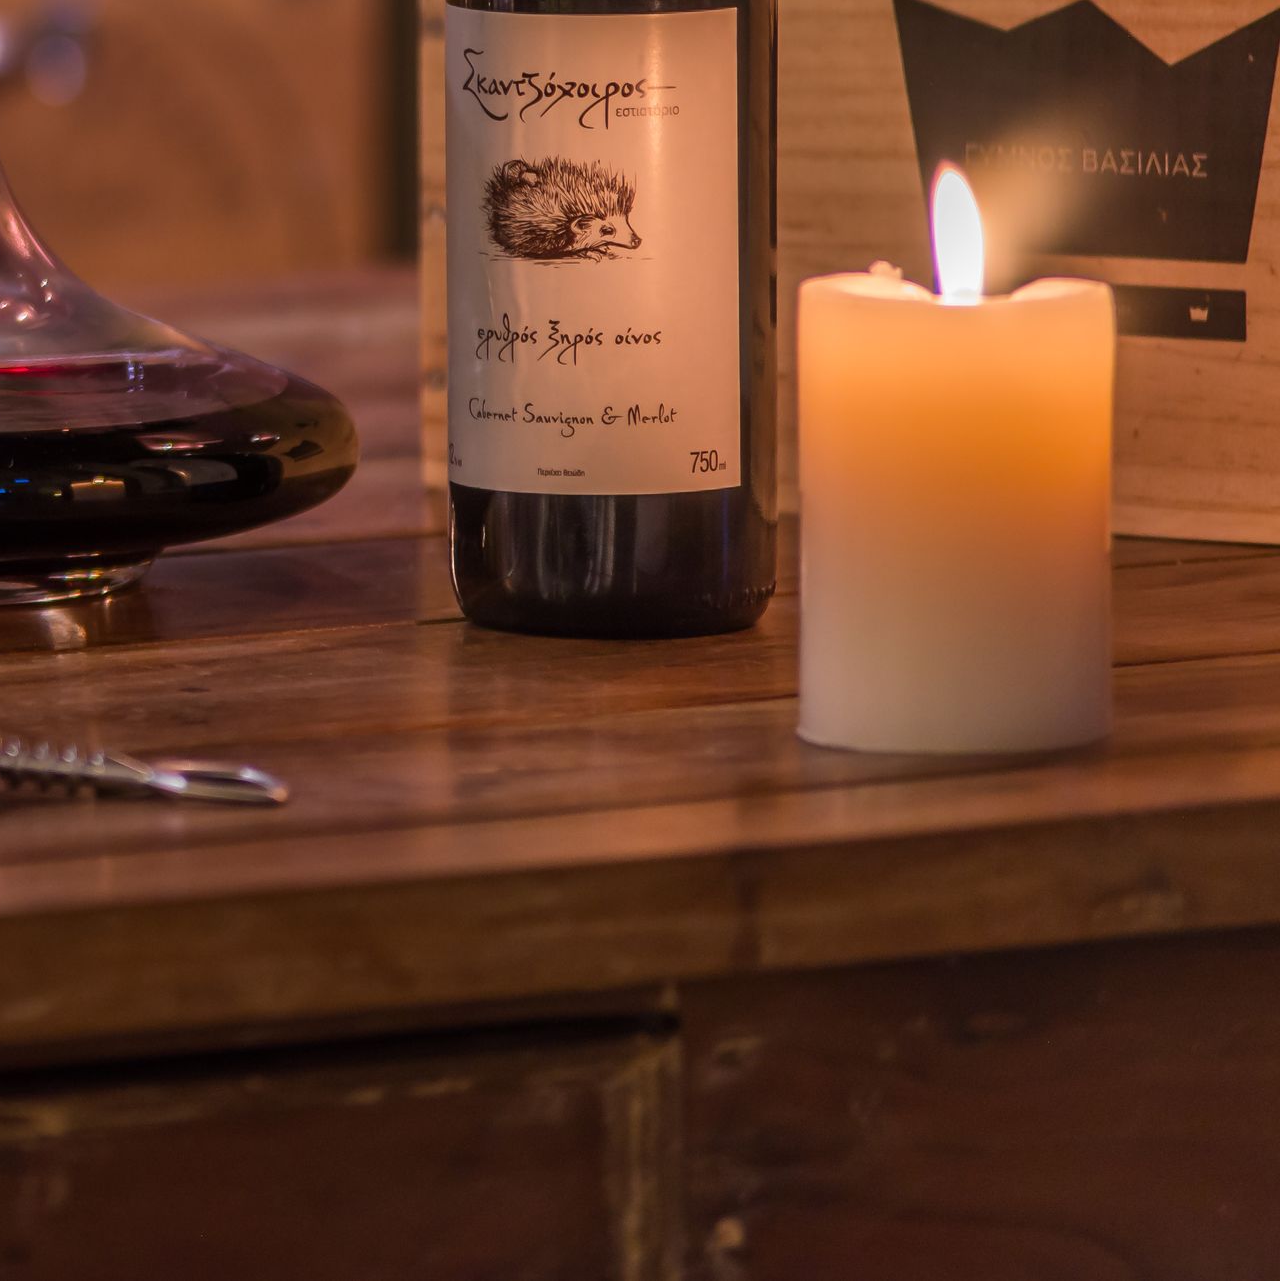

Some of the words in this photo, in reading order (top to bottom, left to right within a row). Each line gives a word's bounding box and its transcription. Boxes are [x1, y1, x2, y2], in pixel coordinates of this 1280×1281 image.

[1082, 147, 1208, 179] ΒΑΣΙΛΙΑΣ
[615, 328, 662, 346] οίνος
[469, 397, 517, 422] Cabernet
[523, 403, 593, 437] Sauvignon
[601, 406, 622, 425] &
[628, 403, 678, 425] Merlot
